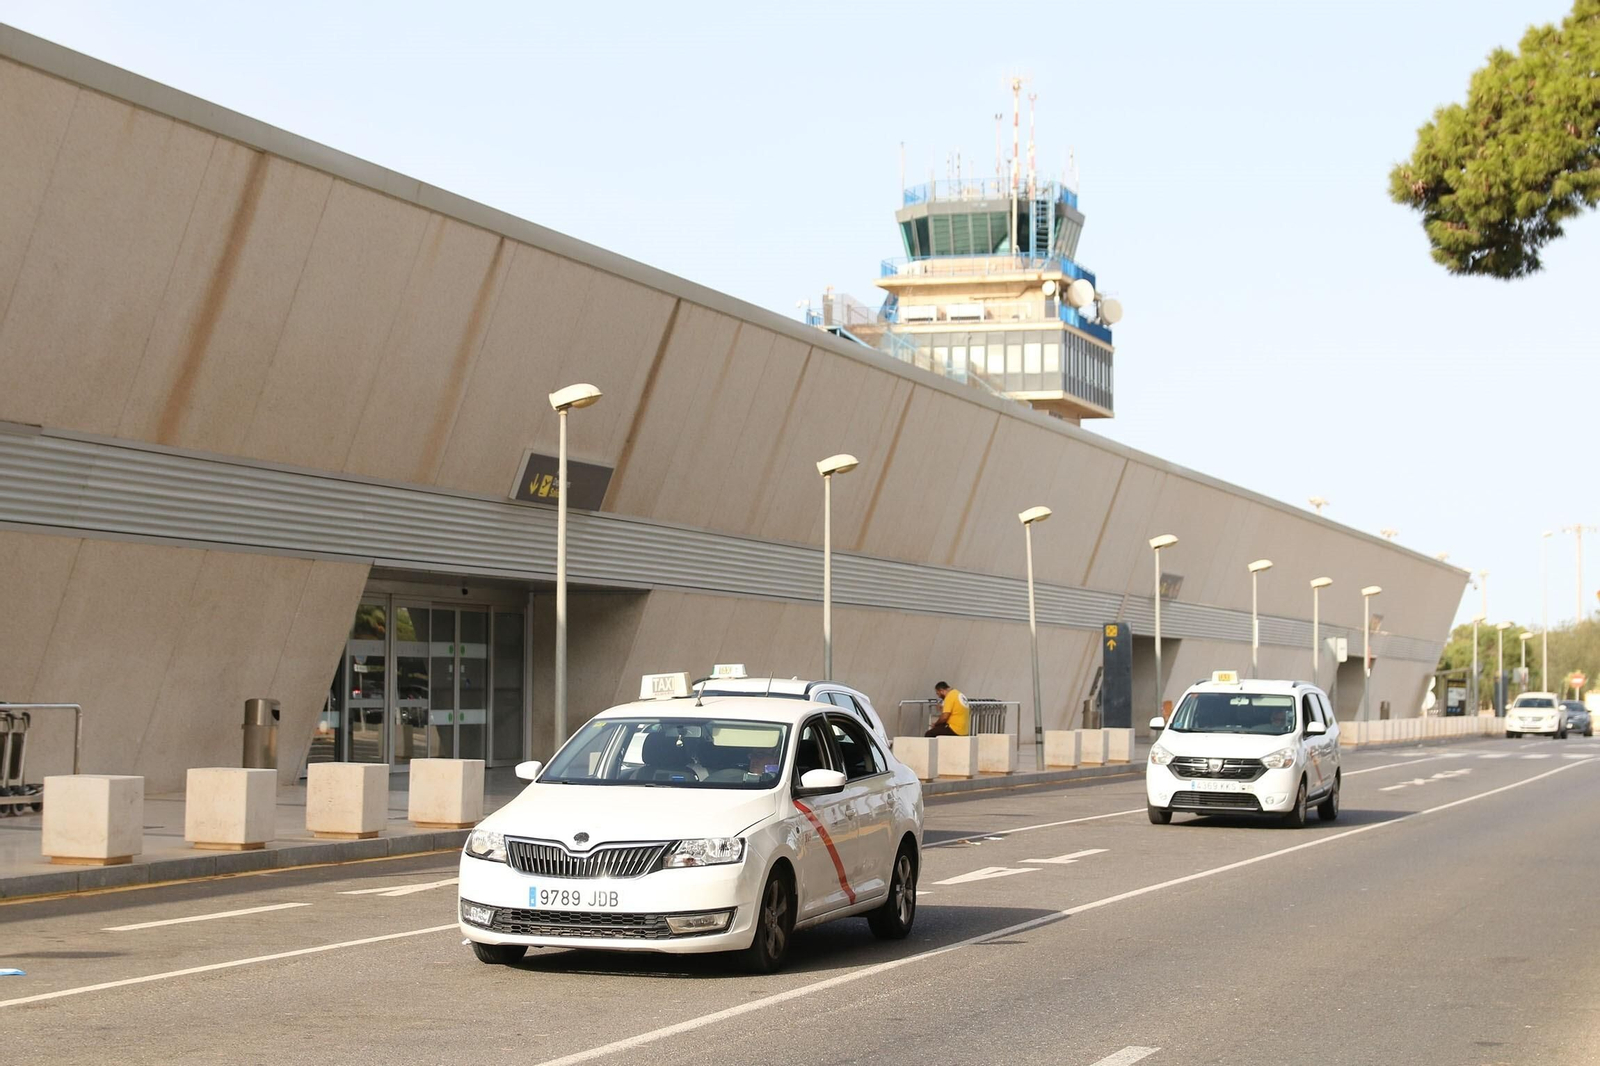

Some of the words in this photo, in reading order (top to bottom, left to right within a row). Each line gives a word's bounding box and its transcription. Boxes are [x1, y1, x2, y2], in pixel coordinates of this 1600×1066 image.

[652, 678, 676, 691] TAXI
[540, 889, 580, 906] 9789
[588, 891, 619, 907] JDB
